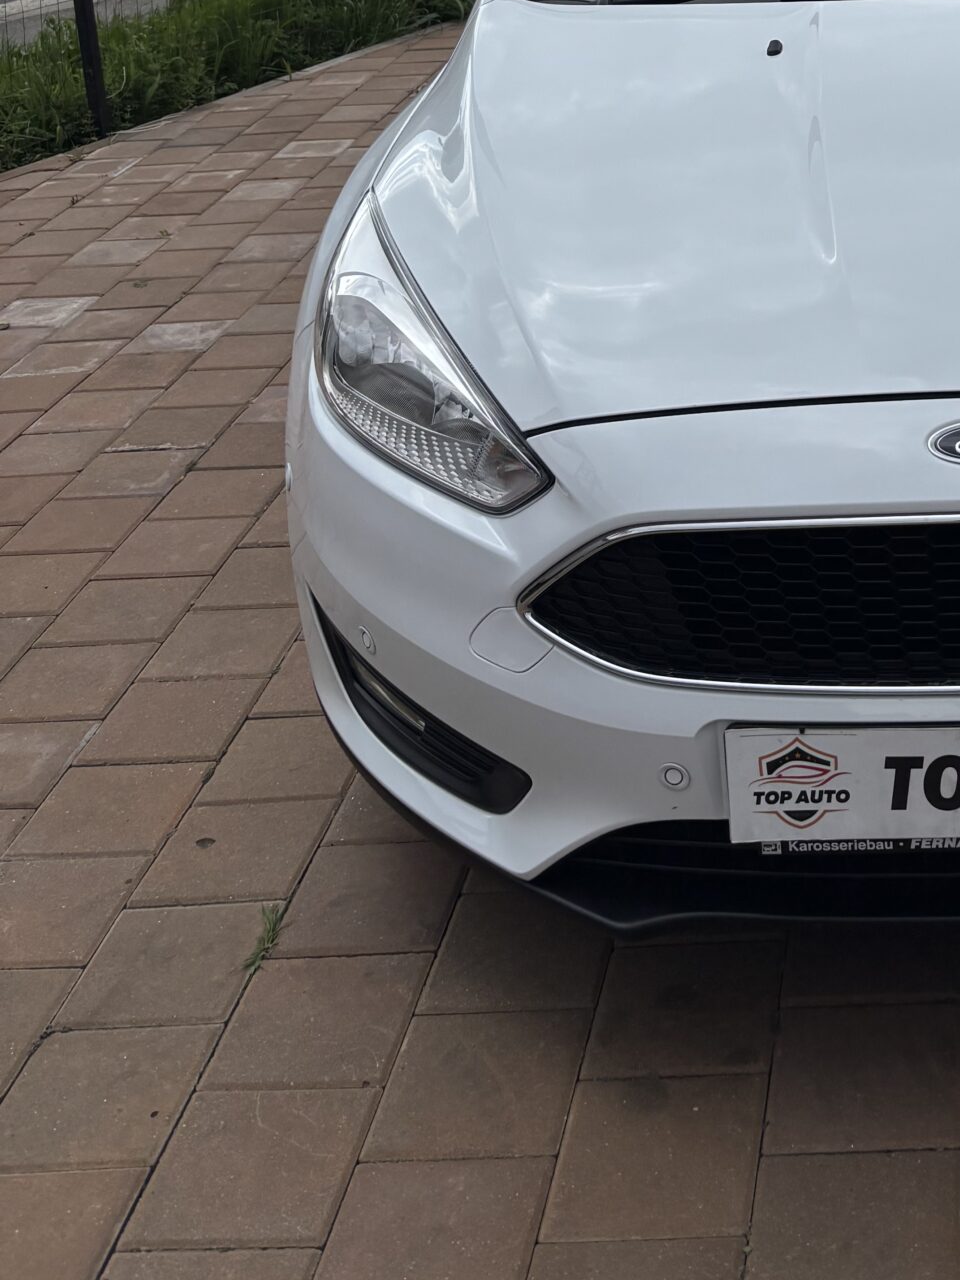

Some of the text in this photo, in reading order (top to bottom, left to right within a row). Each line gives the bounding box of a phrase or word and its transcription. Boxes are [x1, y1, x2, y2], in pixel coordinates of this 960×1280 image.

[753, 789, 851, 806] TOP AUTO
[788, 839, 894, 852] Karosseriebau
